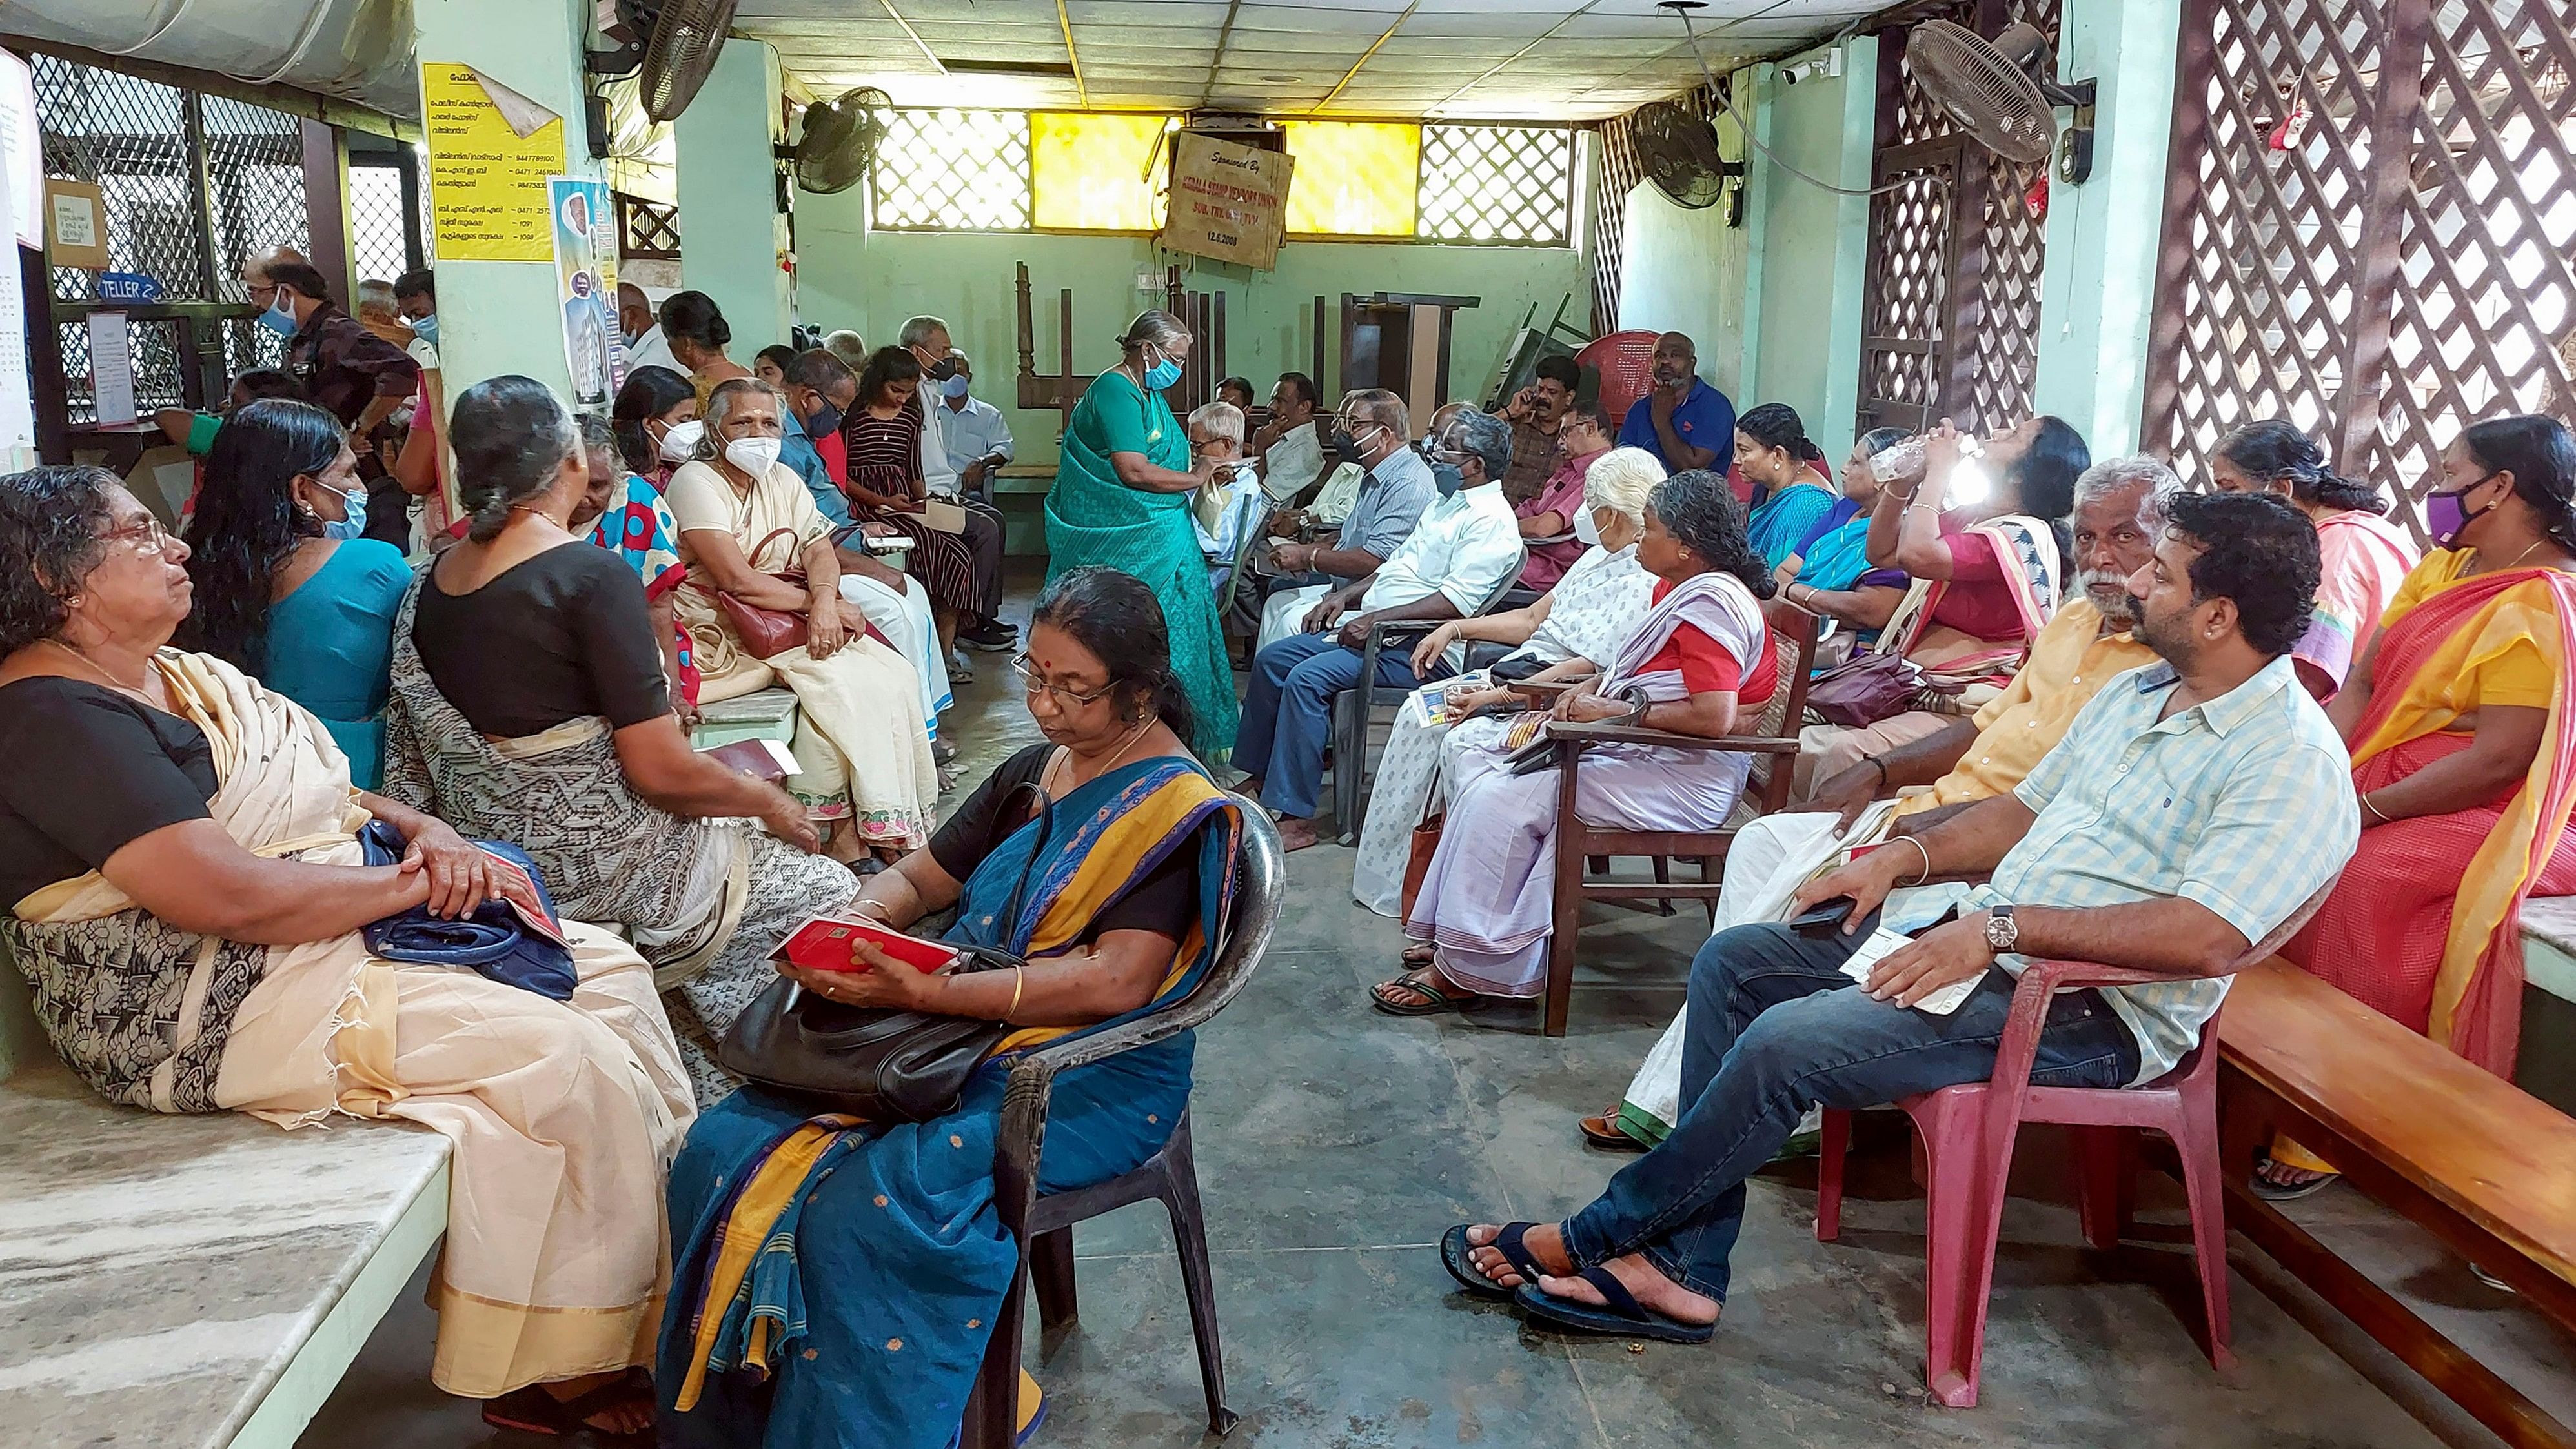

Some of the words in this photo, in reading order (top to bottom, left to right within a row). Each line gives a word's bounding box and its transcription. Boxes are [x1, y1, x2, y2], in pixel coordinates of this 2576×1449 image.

[1211, 152, 1248, 169] Sponsored
[1250, 160, 1260, 174] By
[1182, 176, 1206, 193] KERALA
[1207, 181, 1229, 196] STAMP
[1258, 192, 1279, 208] UNION
[1193, 201, 1208, 216] SUB.
[102, 280, 140, 298] TELLER
[141, 283, 154, 299] 2
